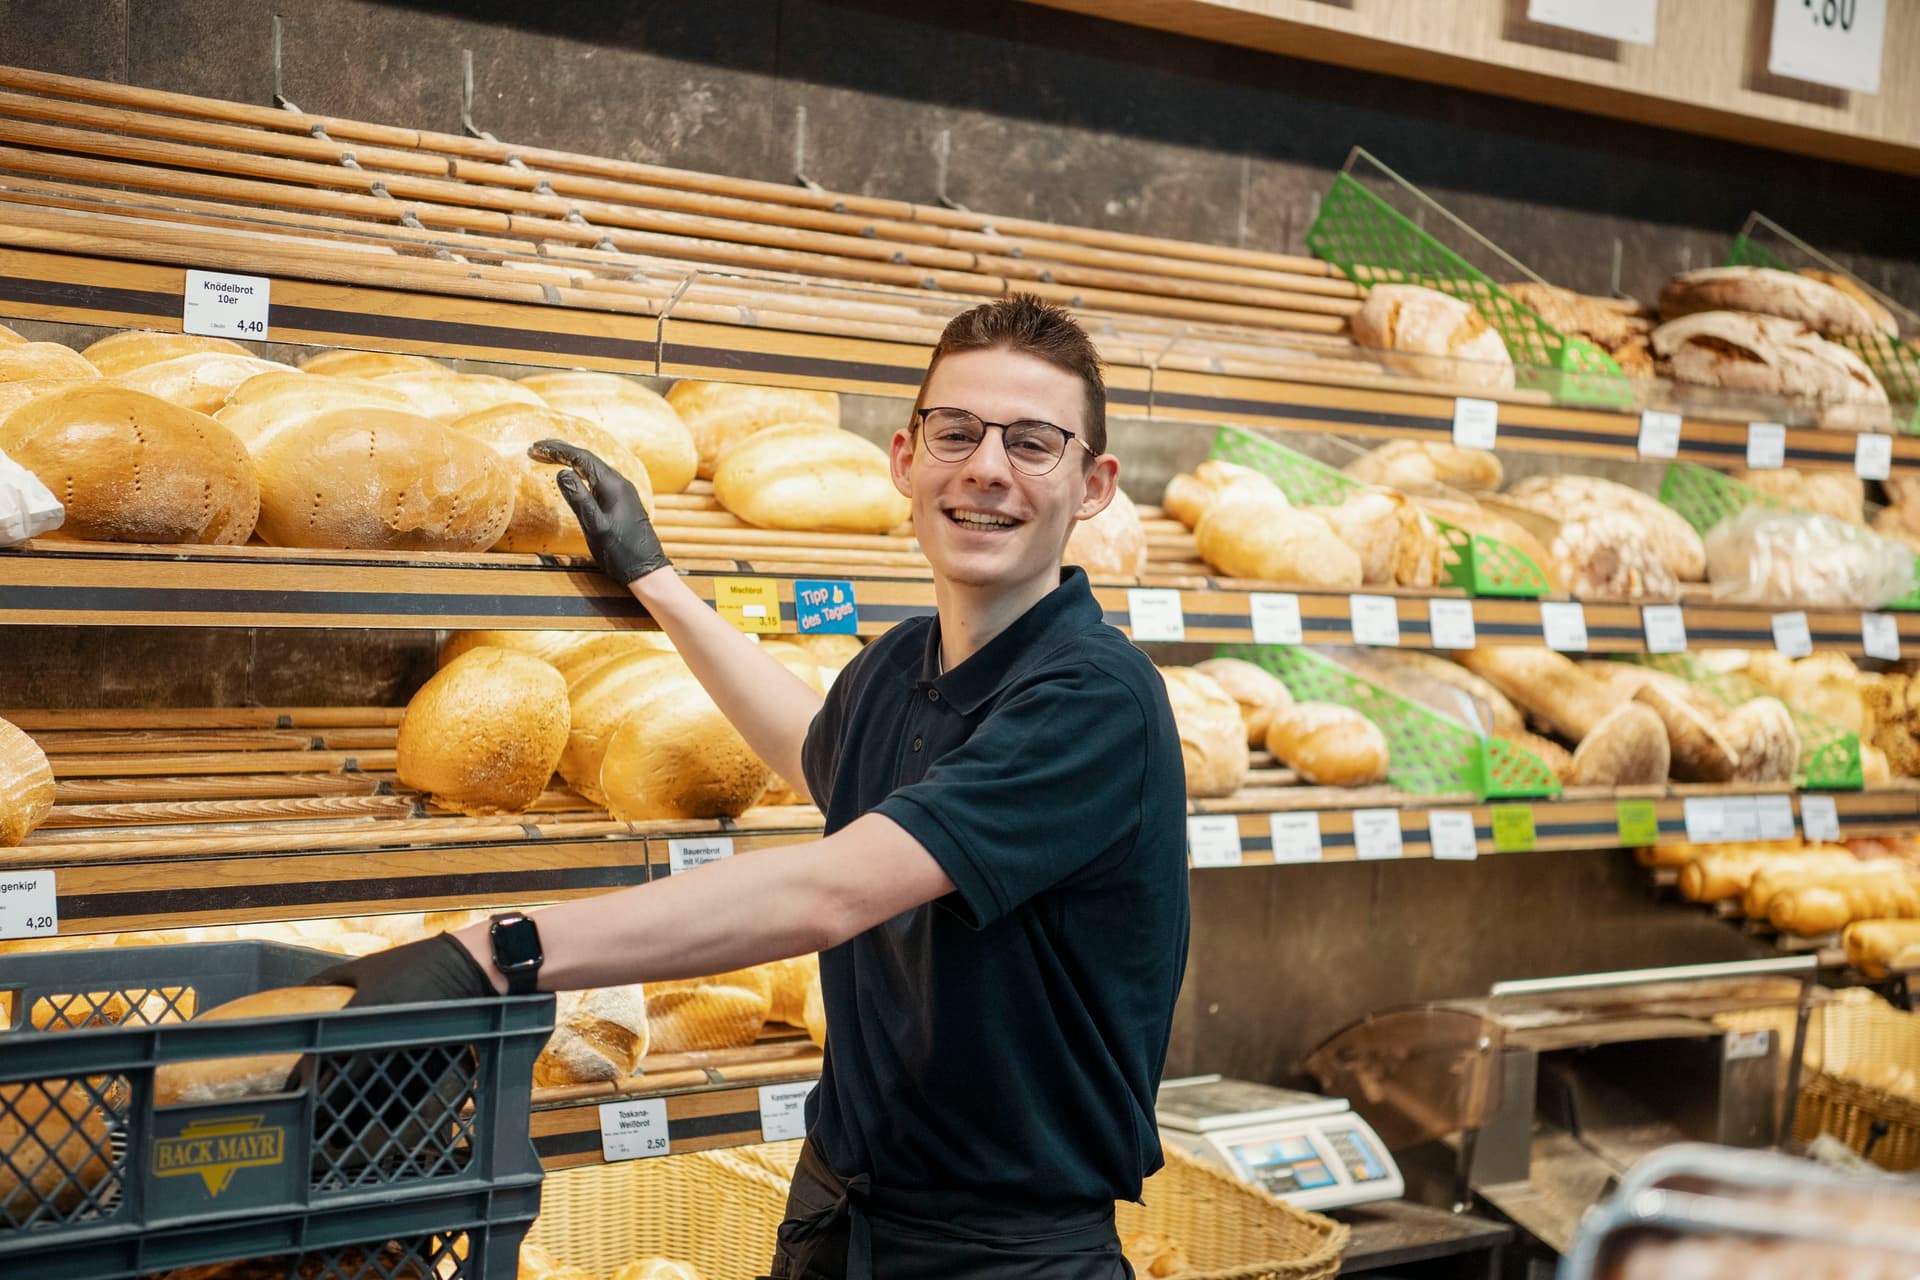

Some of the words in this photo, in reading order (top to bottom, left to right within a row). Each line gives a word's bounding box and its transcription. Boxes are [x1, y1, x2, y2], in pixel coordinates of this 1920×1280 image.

[203, 281, 254, 295] Knödelbrot
[217, 294, 239, 305] 10er
[237, 319, 264, 333] 4,40
[730, 585, 763, 594] Mischbrot
[801, 588, 829, 606] Tipp
[802, 613, 823, 630] des
[822, 602, 854, 623] Tages
[683, 847, 720, 856] Bauernbrot
[683, 857, 694, 865] mit
[0, 881, 37, 893] genkipf
[26, 916, 53, 930] 4,20
[618, 1109, 649, 1119] Toskana-
[619, 1119, 651, 1129] Weißbrot
[647, 1138, 666, 1150] 2,50
[158, 1139, 214, 1169] BACK
[217, 1133, 276, 1162] MAYR
